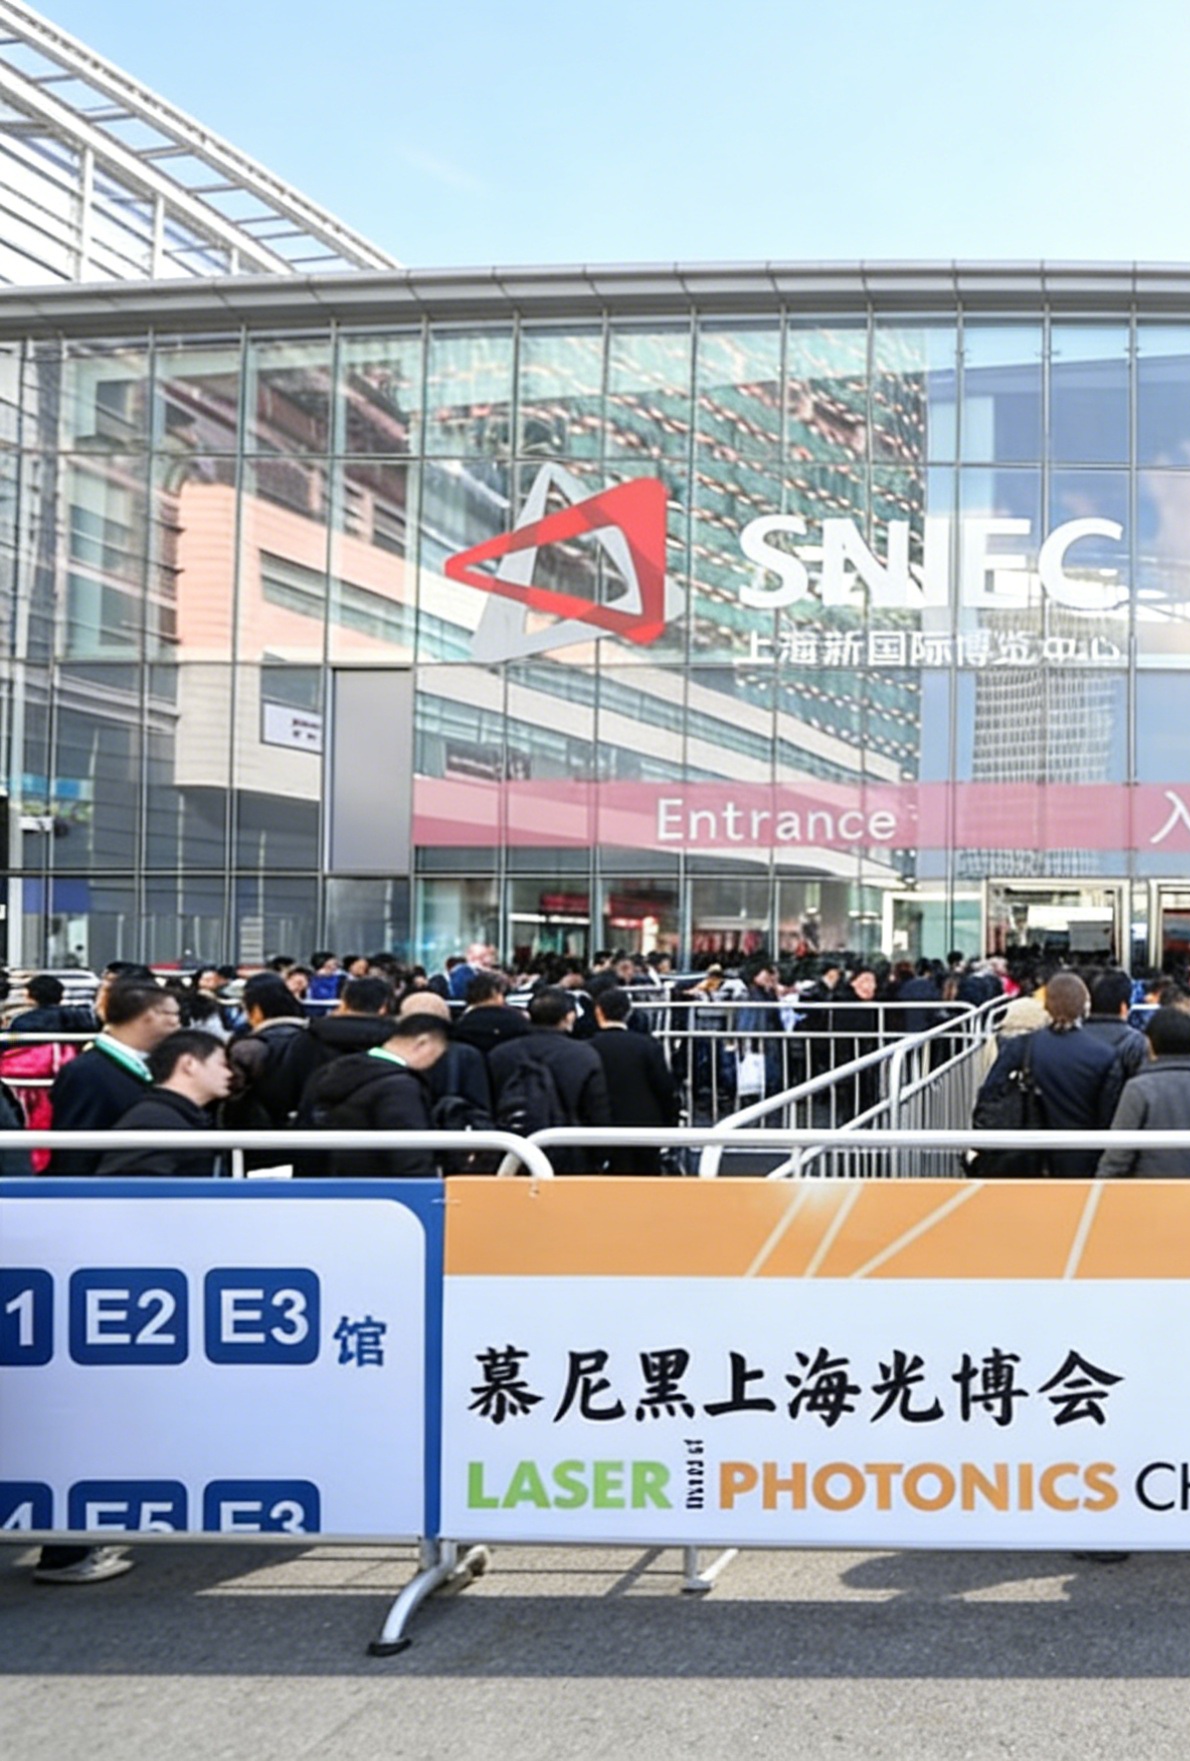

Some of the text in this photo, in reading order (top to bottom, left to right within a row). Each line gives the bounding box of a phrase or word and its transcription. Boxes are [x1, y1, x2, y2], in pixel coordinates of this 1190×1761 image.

[738, 513, 1131, 611] SNIEC
[657, 798, 896, 842] Entrance
[85, 1289, 176, 1345] E2
[219, 1288, 309, 1345] E3
[333, 1315, 387, 1367] 馆
[466, 1344, 1125, 1427] 慕尼黑上海光博会
[467, 1459, 674, 1511] LASER
[719, 1461, 1119, 1512] PHOTONICS
